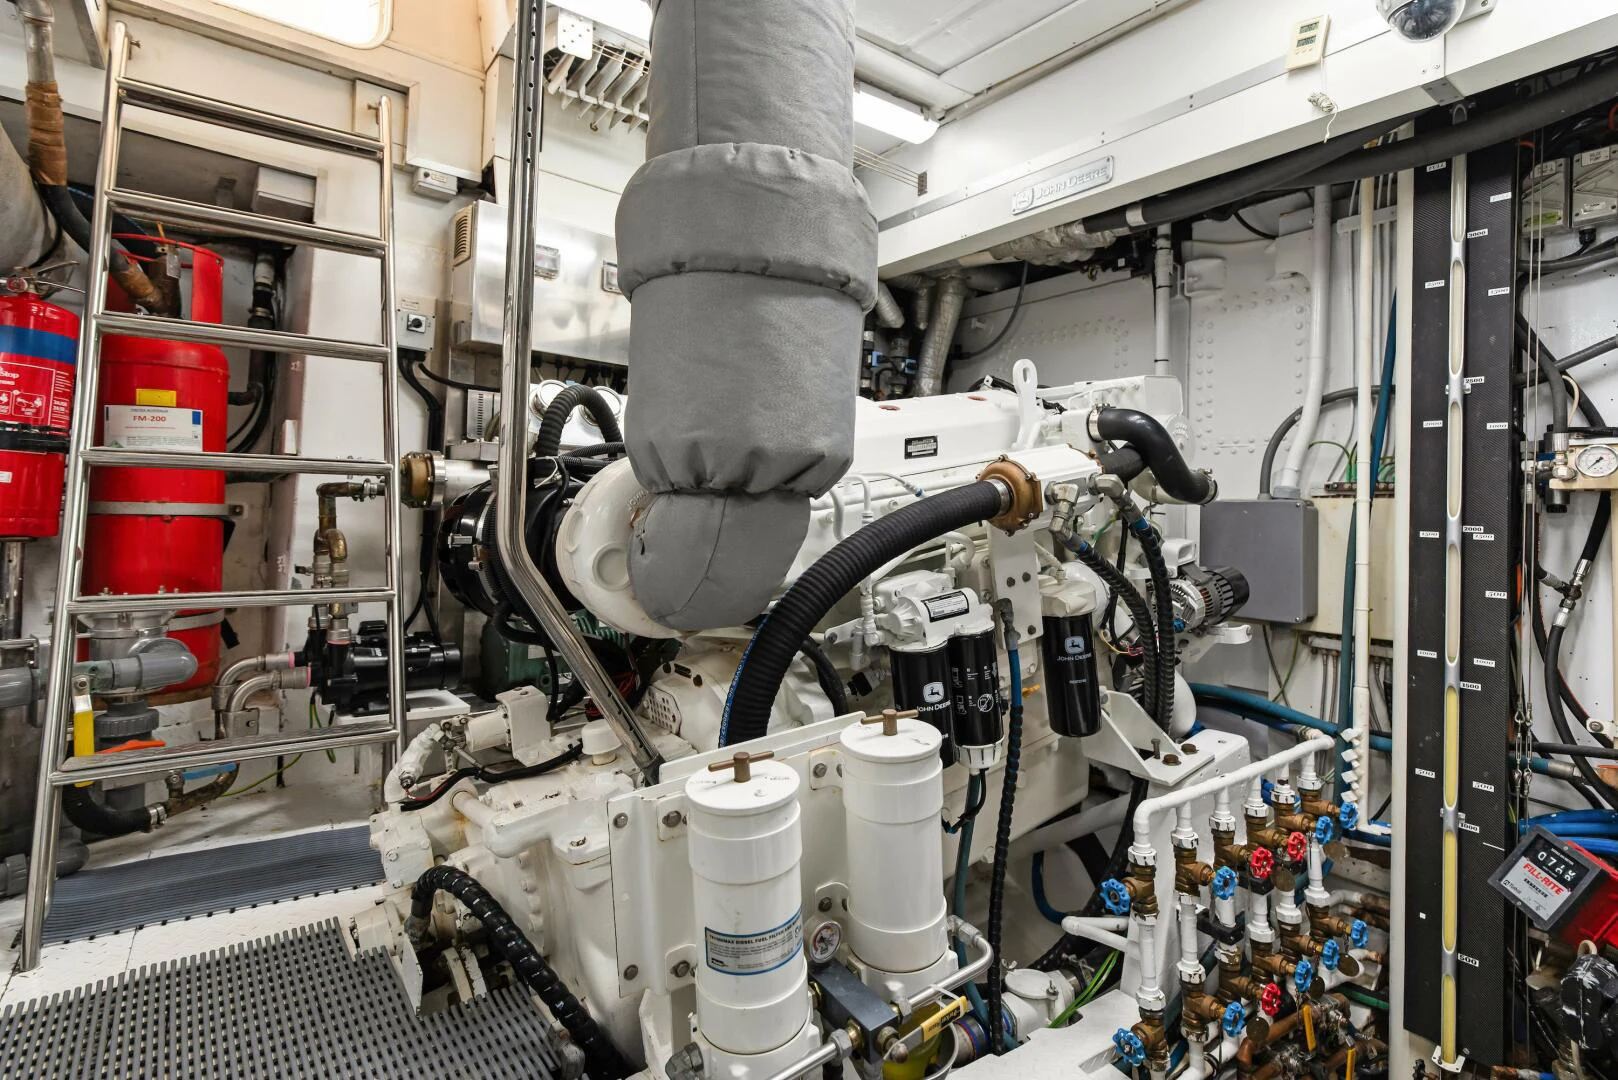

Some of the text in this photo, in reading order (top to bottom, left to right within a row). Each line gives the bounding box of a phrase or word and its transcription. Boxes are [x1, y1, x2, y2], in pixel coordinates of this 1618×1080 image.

[1037, 167, 1107, 199] JOHN DEERE
[1460, 822, 1478, 832] 1000
[1522, 862, 1564, 896] FILL-RITE
[1459, 953, 1478, 966] 500
